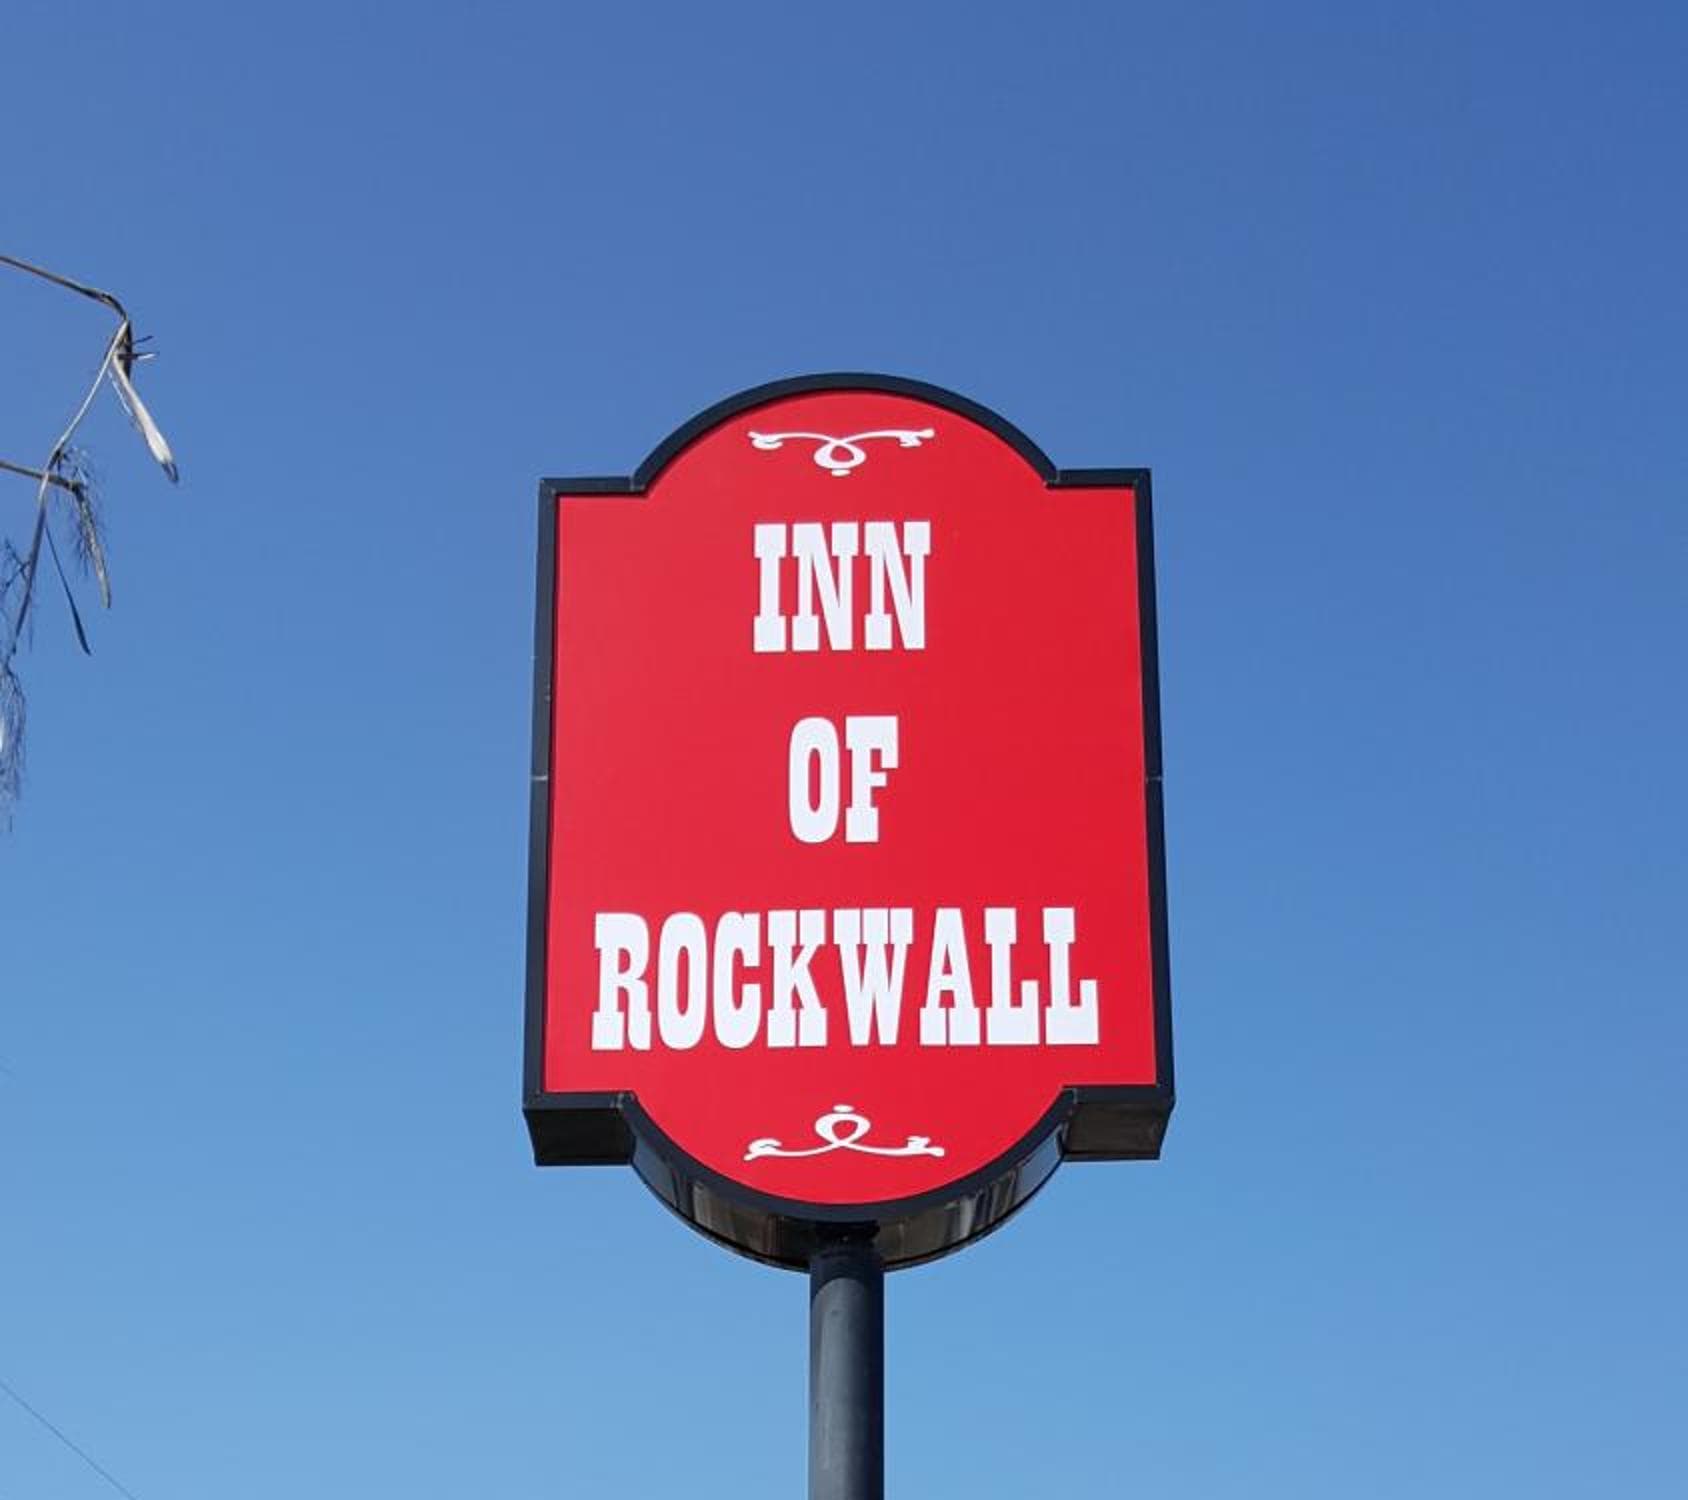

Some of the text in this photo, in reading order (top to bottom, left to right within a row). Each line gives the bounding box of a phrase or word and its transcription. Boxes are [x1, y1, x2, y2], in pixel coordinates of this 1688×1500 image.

[752, 521, 931, 653] INN
[789, 715, 899, 843] OF
[591, 907, 1099, 1051] ROCKWALL
